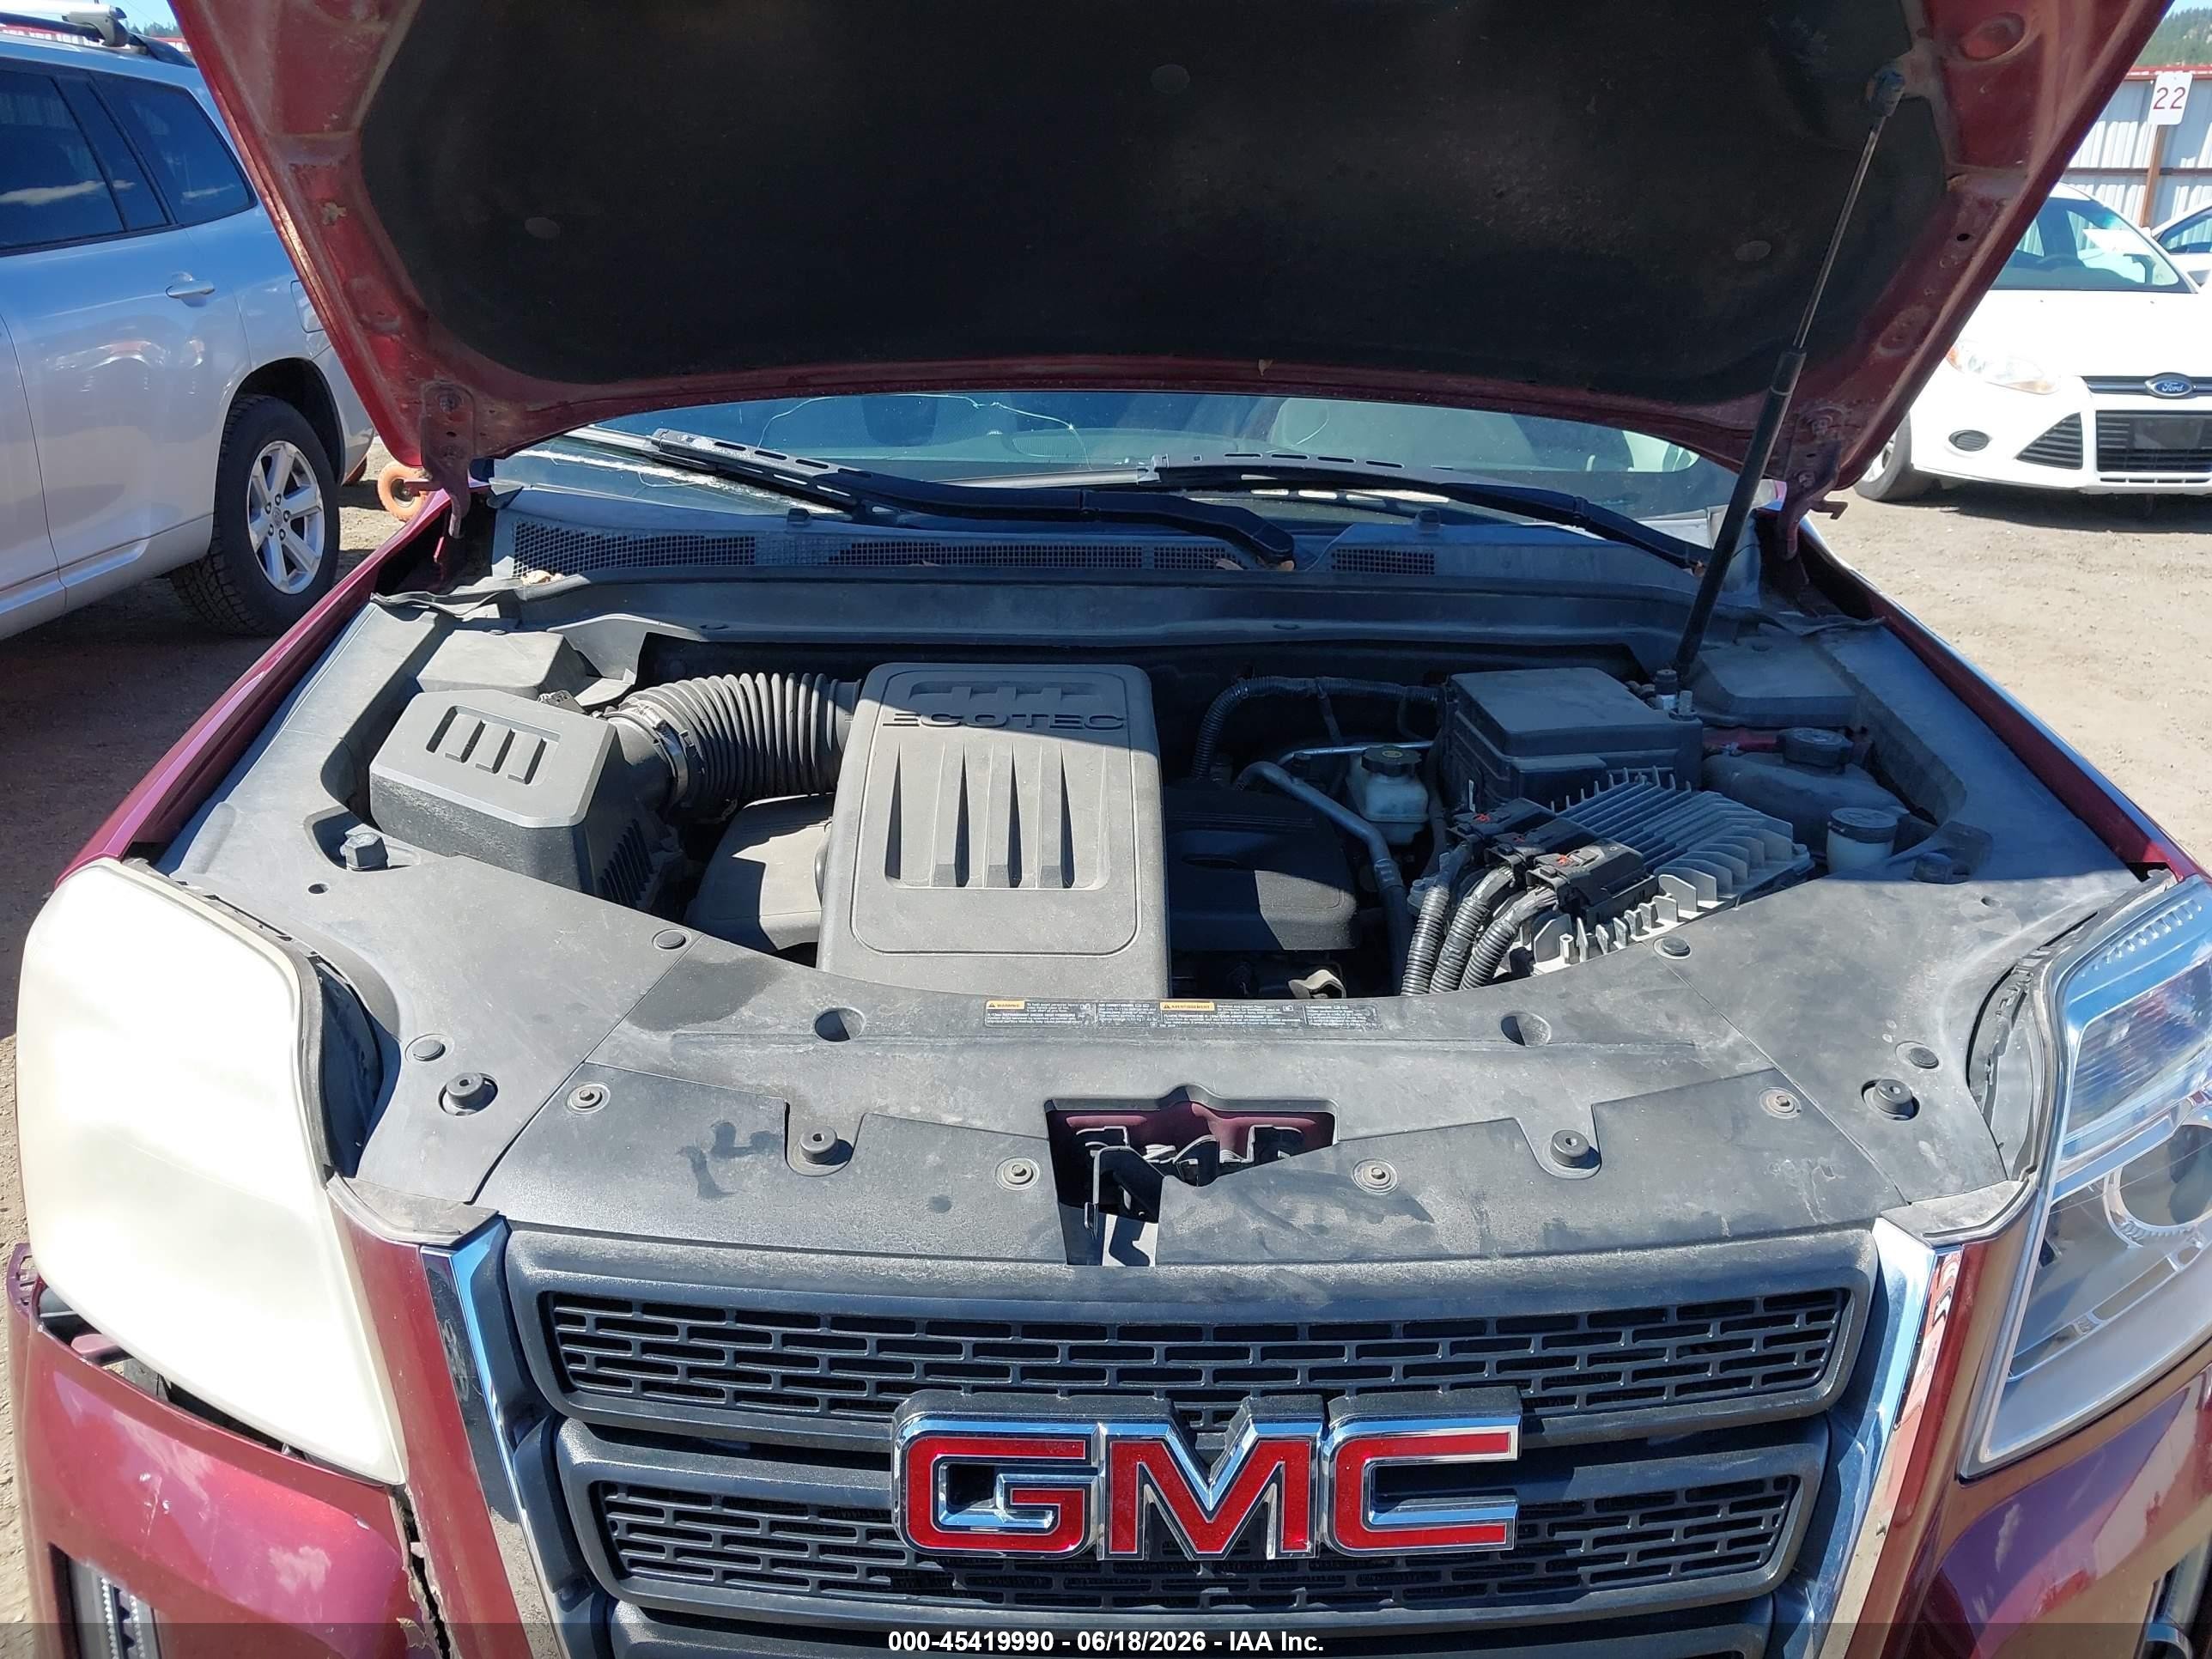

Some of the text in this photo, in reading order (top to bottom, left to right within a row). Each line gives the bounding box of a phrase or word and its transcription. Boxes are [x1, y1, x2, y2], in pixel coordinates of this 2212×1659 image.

[2154, 87, 2186, 110] 22
[2162, 381, 2185, 392] Ford
[882, 713, 1125, 730] ECOTEC
[896, 1408, 1521, 1559] GMC
